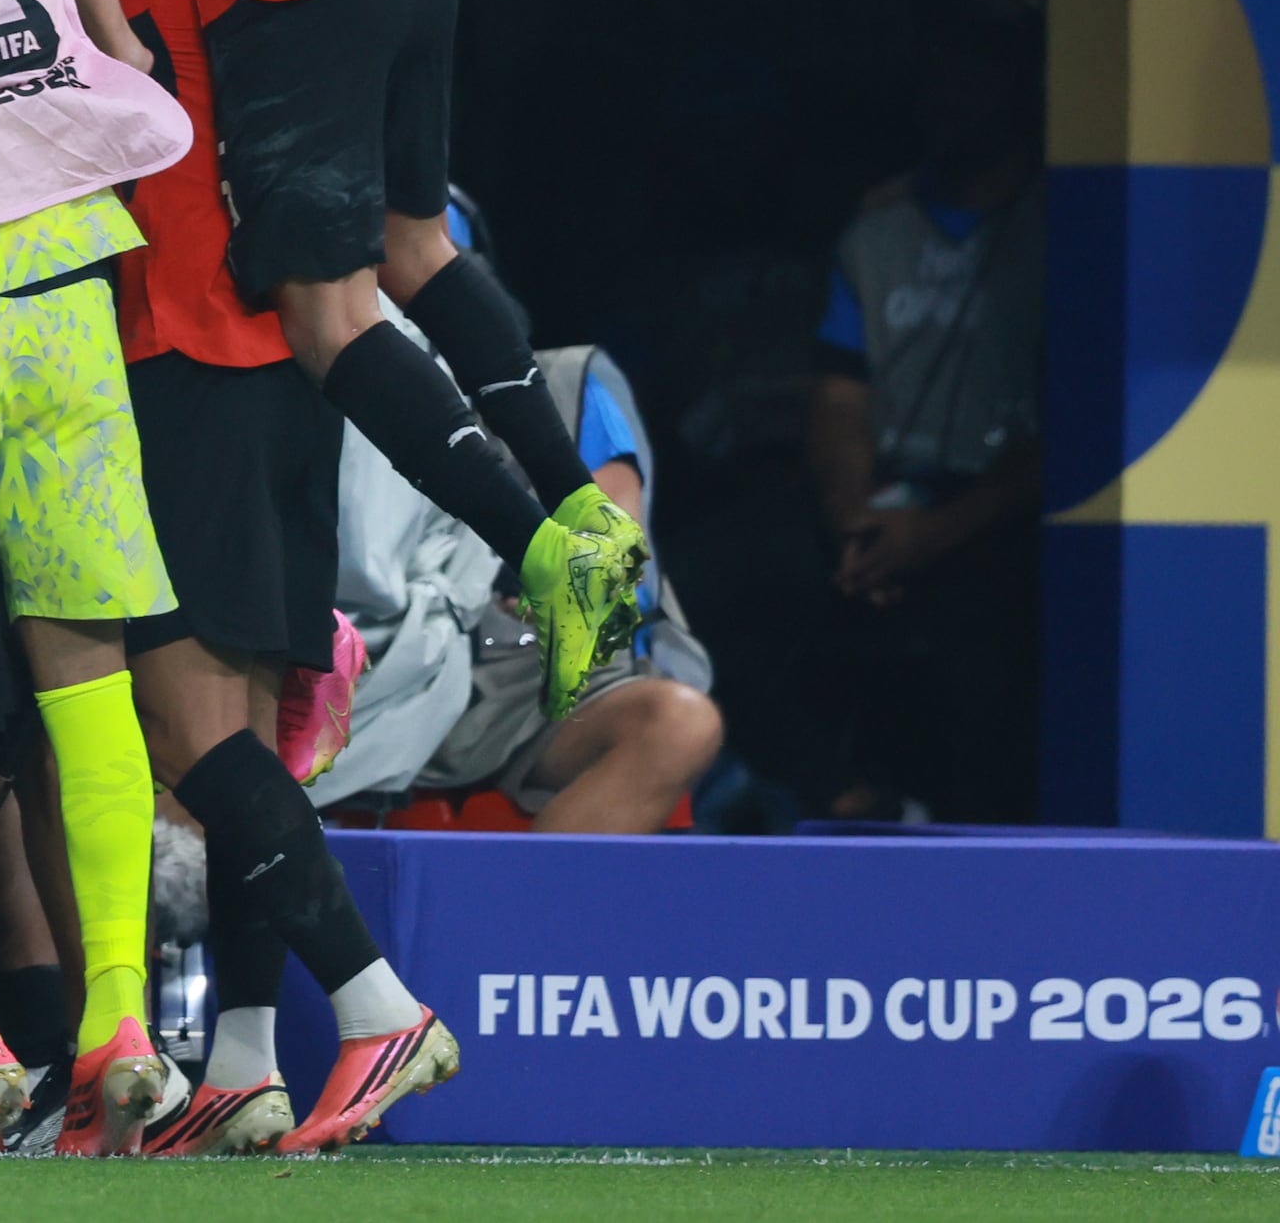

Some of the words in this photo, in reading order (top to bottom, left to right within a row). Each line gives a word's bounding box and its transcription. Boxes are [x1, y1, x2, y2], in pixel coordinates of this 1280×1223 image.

[478, 973, 620, 1038] FIFA
[628, 975, 873, 1041] WORLD
[884, 977, 1018, 1042] CUP
[1029, 976, 1264, 1043] 2026
